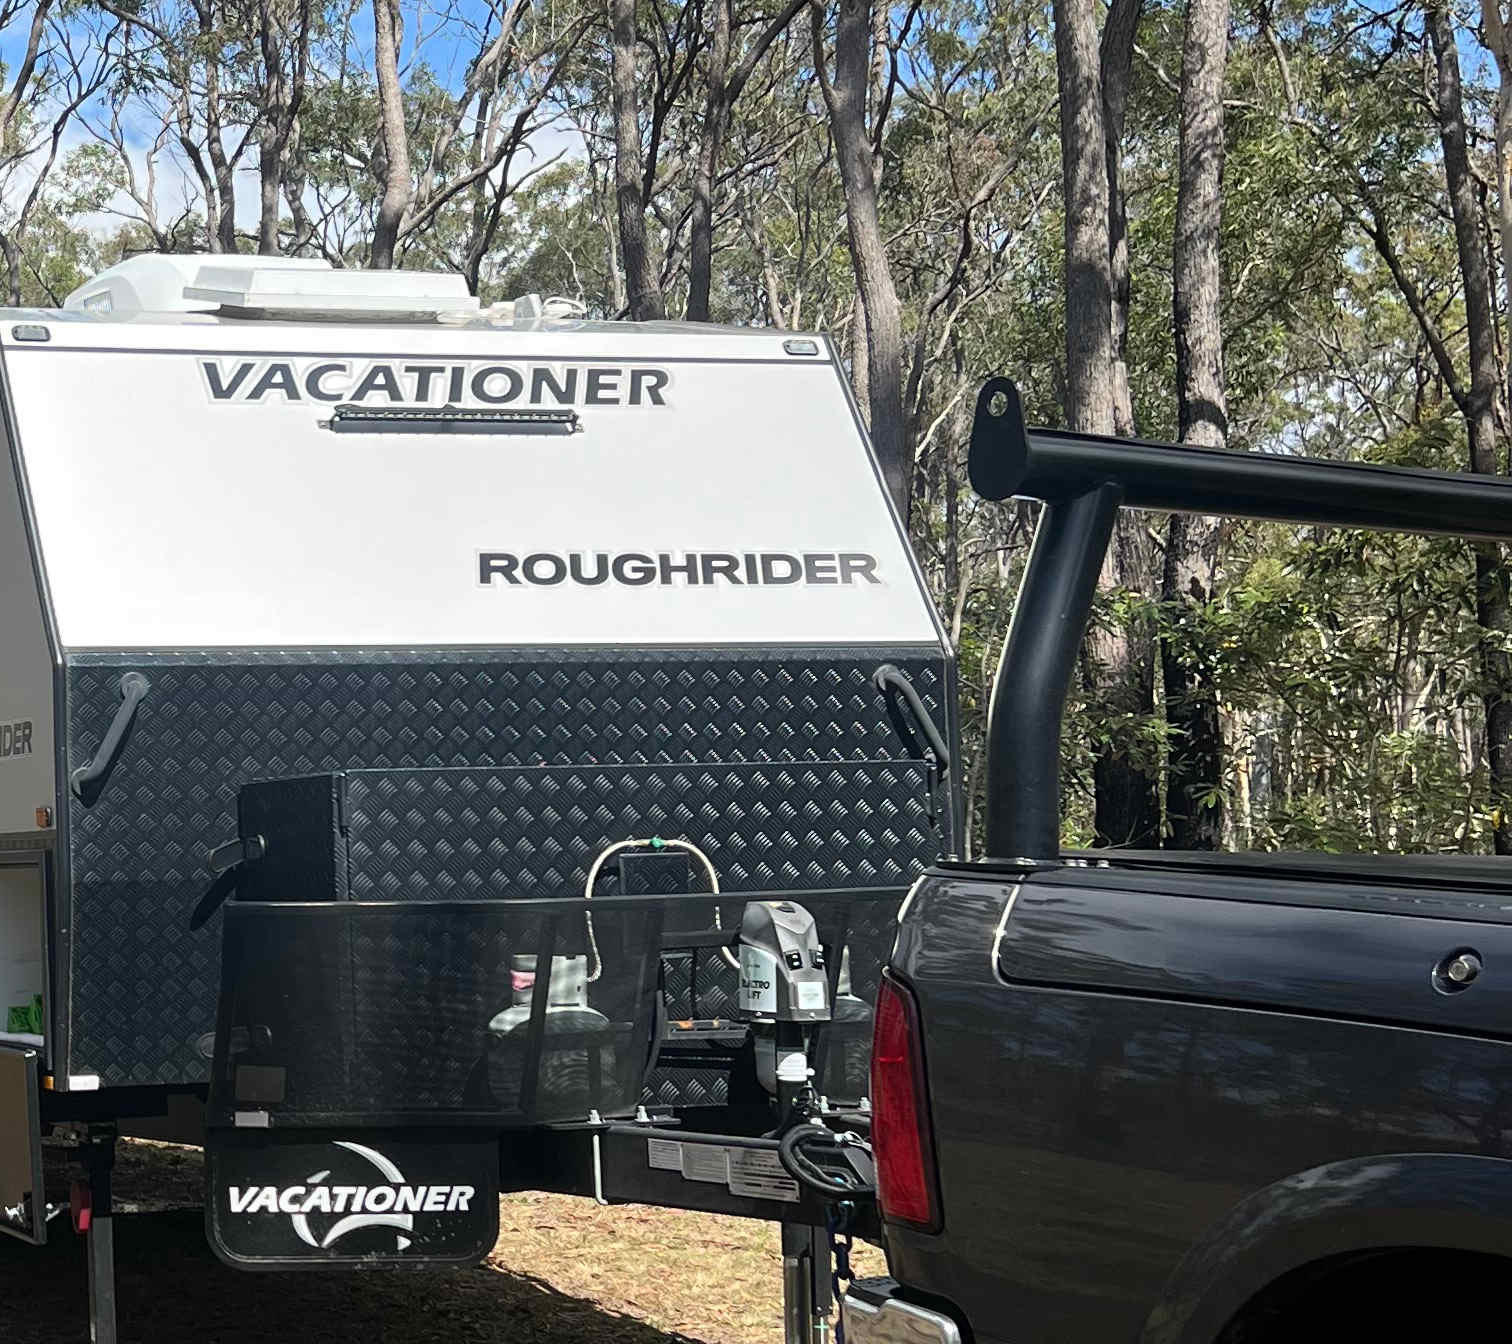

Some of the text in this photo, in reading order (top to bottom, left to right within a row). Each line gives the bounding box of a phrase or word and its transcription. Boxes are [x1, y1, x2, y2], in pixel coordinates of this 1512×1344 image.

[202, 360, 671, 407] VACATIONER
[479, 552, 881, 586] ROUGHRIDER
[229, 1185, 475, 1213] VACATIONER
